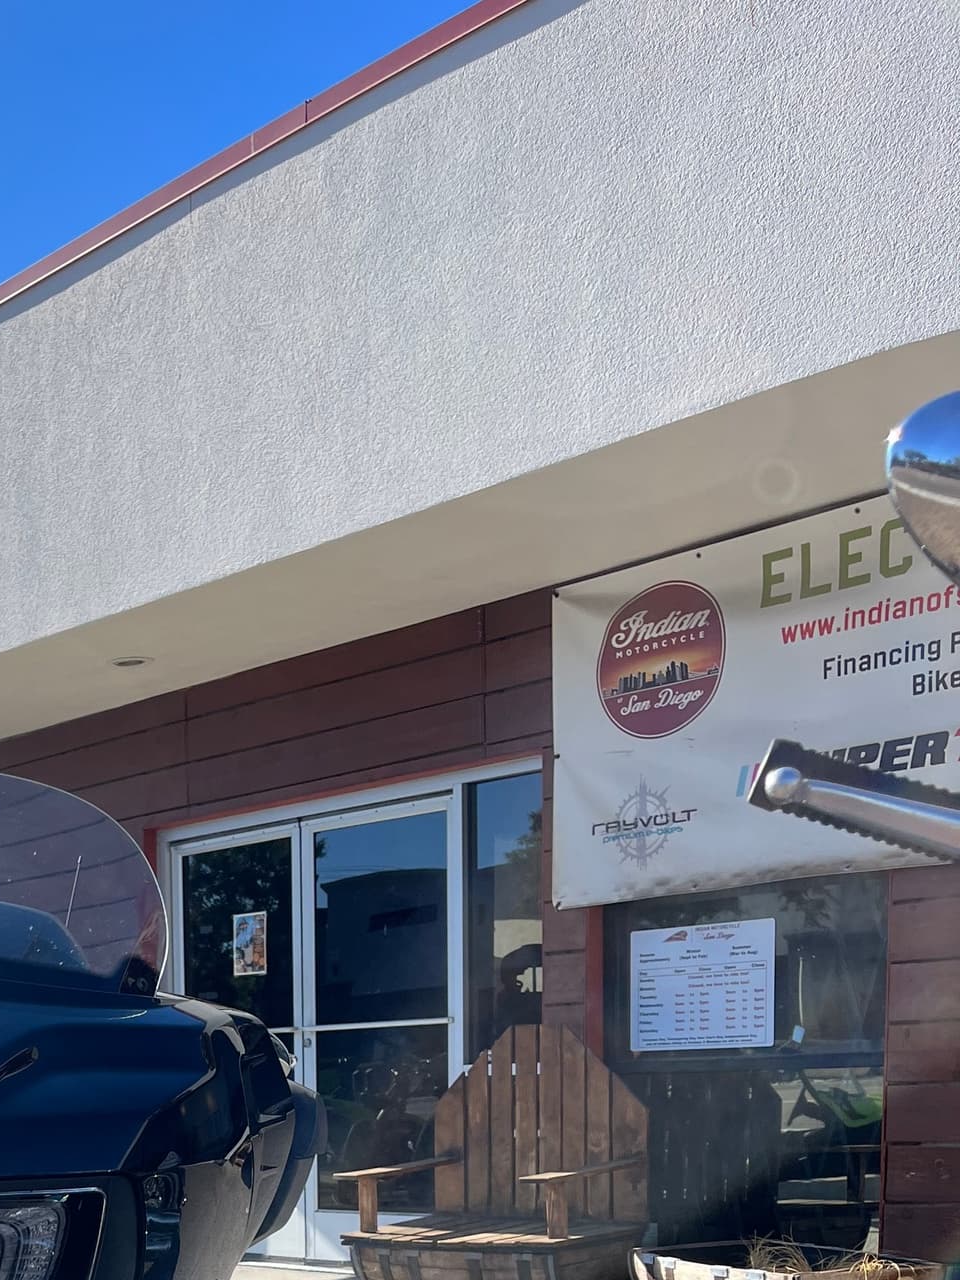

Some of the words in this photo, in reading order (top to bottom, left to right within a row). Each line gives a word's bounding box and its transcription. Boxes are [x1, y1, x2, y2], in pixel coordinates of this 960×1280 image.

[760, 517, 914, 609] ELEC
[611, 609, 711, 648] Indian
[781, 584, 960, 645] www.indianof
[615, 631, 705, 660] MOTORCYCLE
[823, 639, 942, 680] Financing
[620, 695, 651, 716] San
[654, 688, 704, 710] Diego
[818, 729, 950, 772] PER
